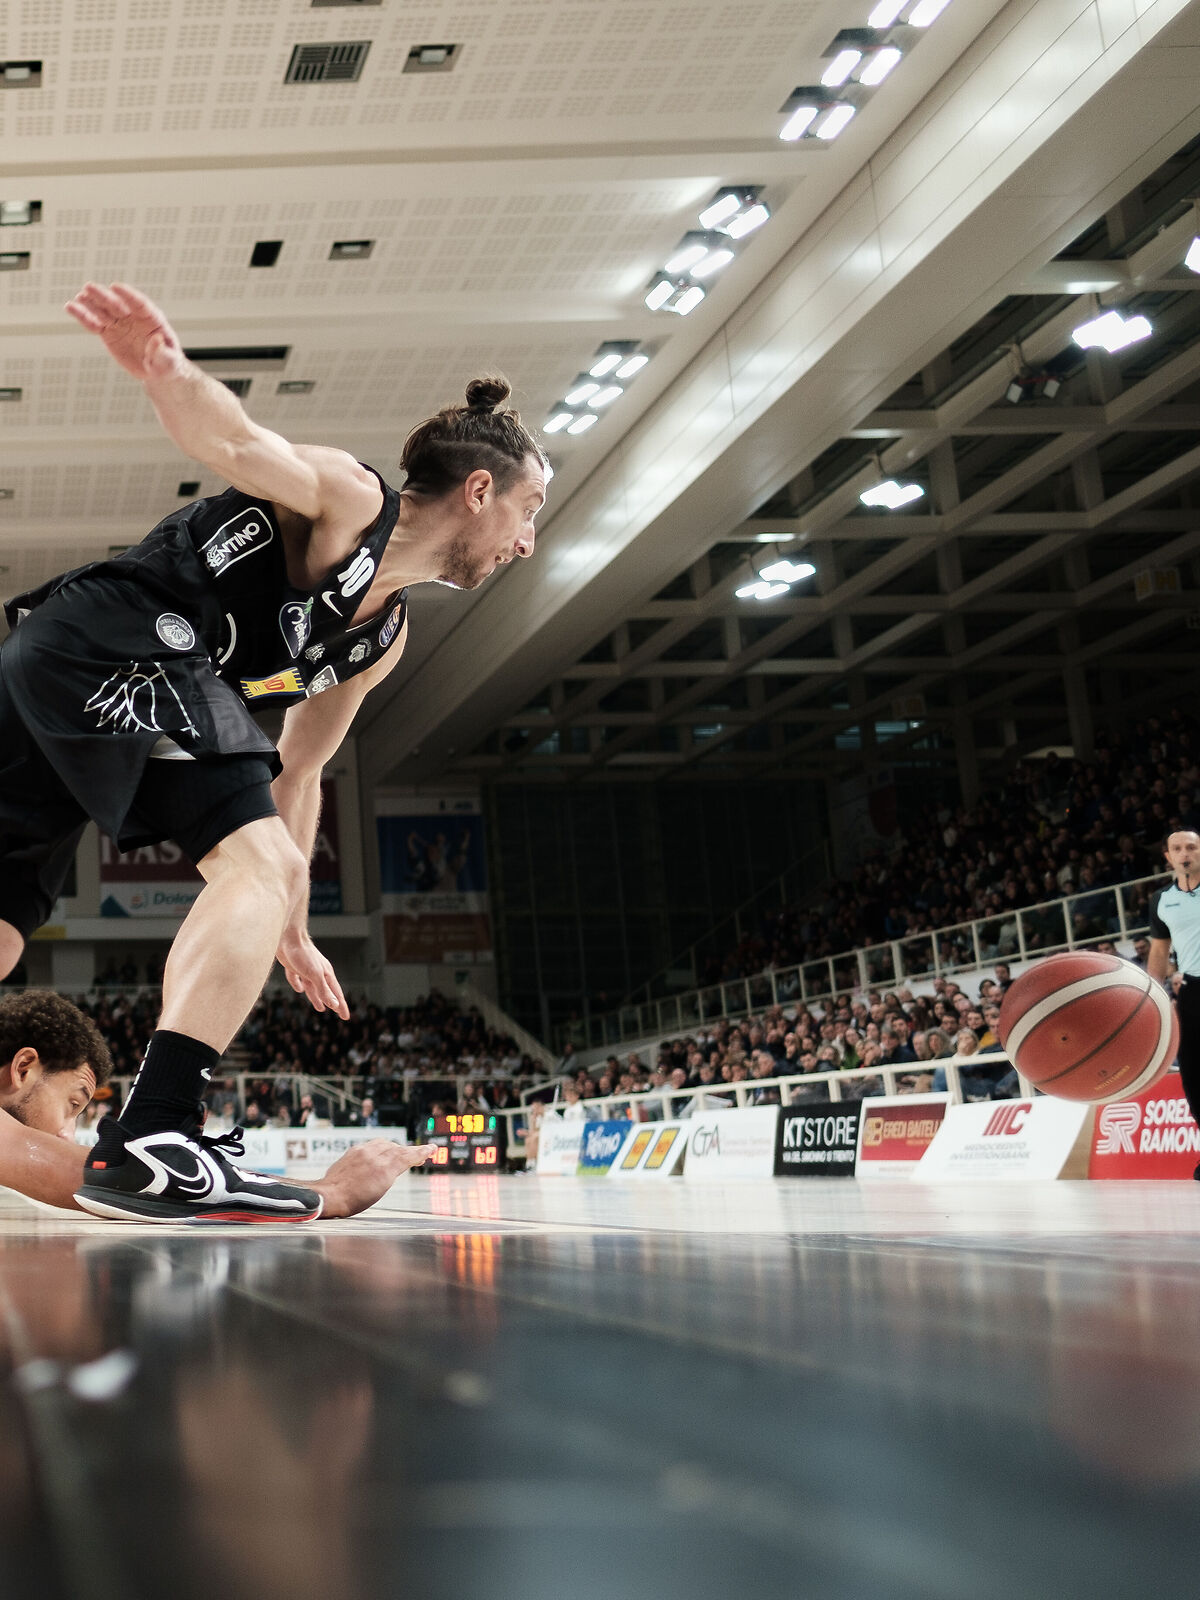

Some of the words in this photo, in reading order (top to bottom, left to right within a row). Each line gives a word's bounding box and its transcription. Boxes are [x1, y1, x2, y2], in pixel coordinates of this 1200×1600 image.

[337, 546, 375, 598] 10
[1140, 1126, 1200, 1154] RAMON
[475, 1146, 497, 1164] 60
